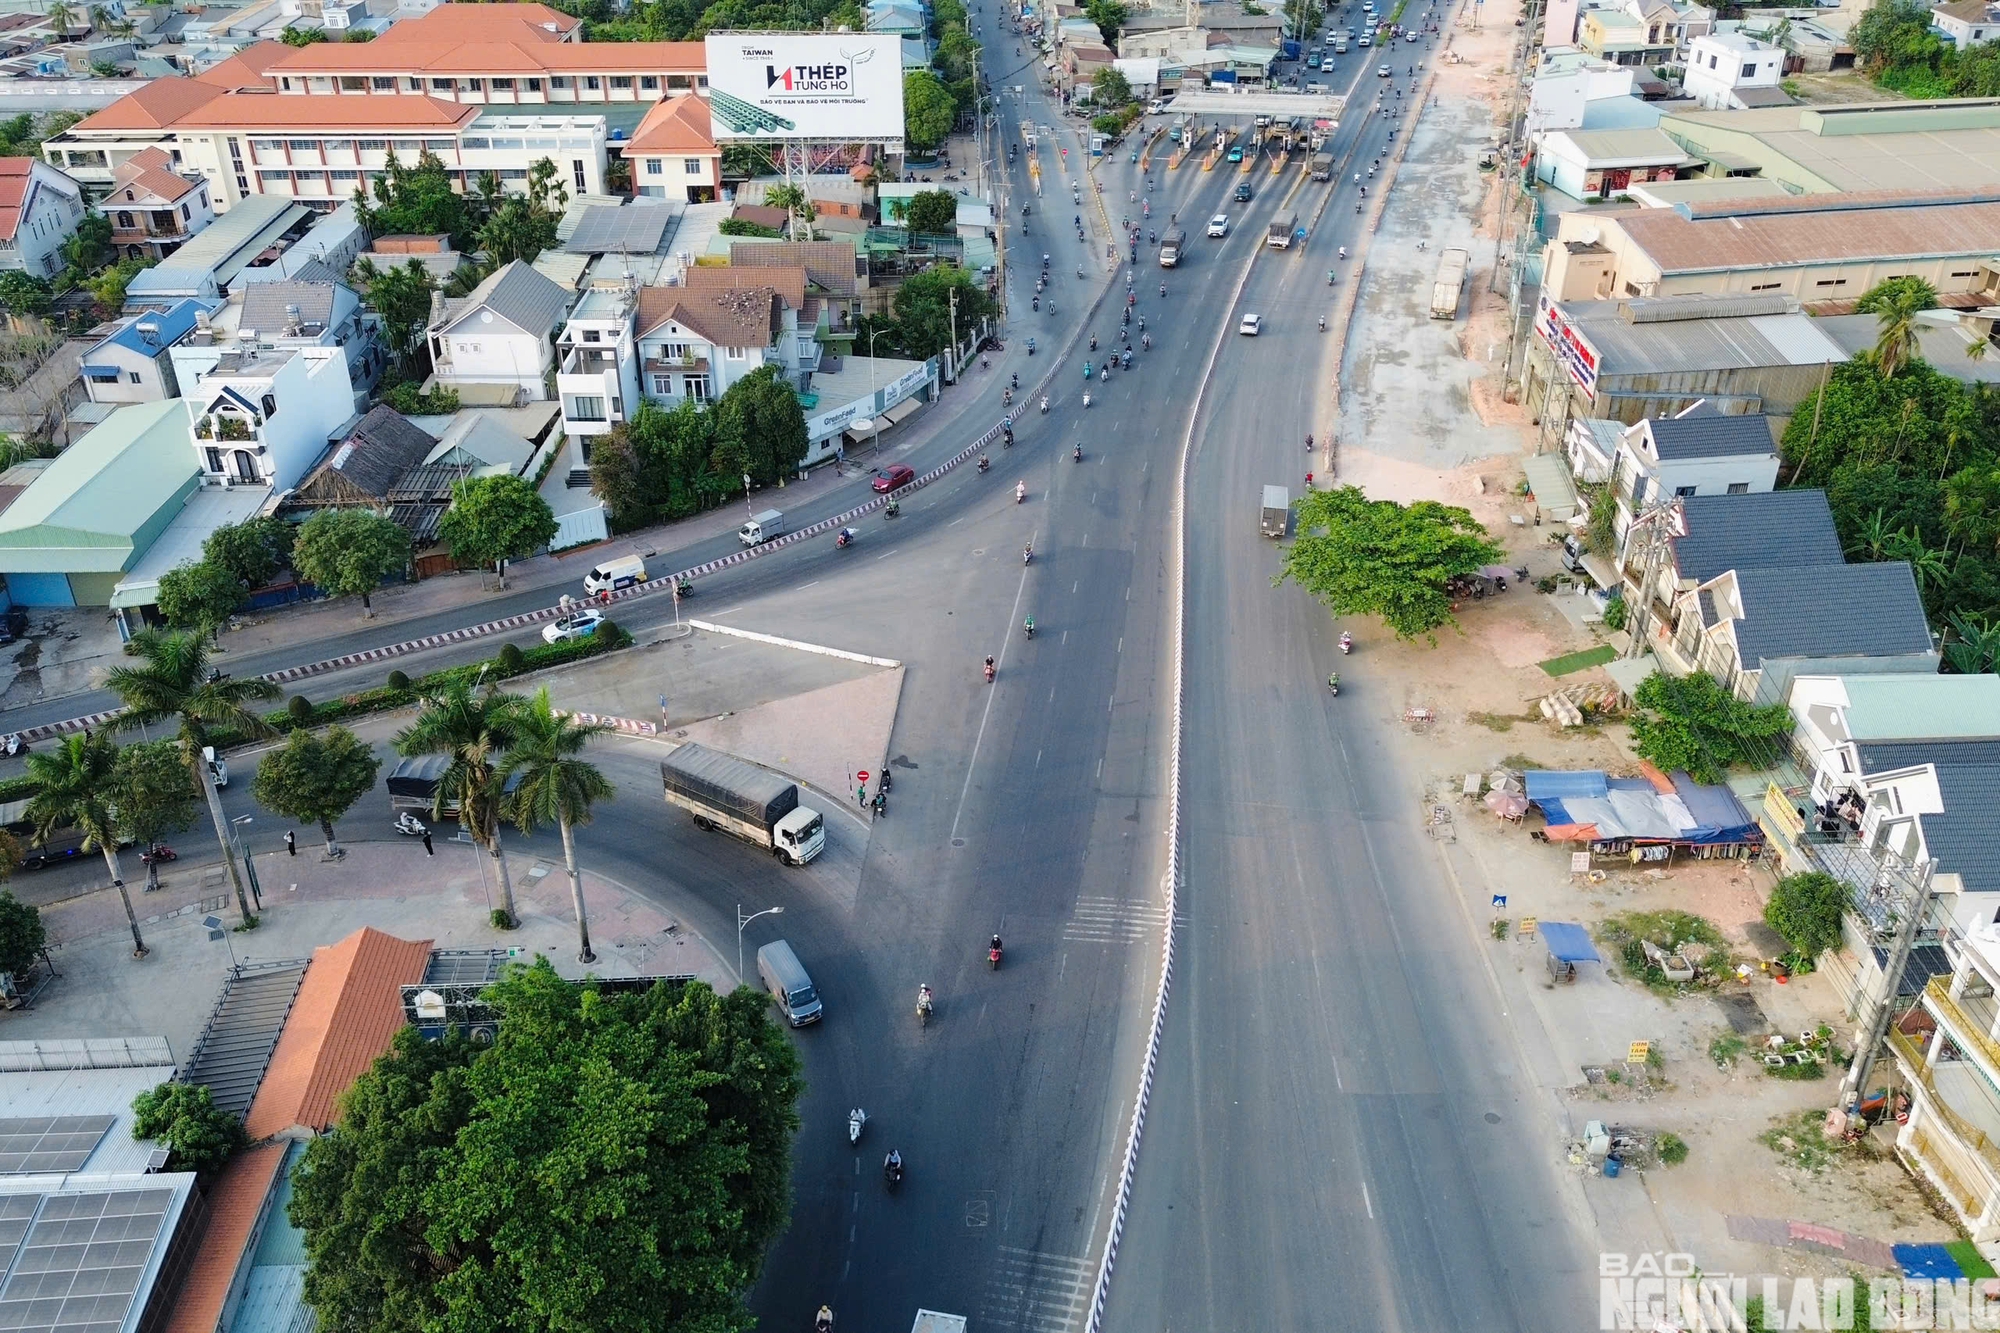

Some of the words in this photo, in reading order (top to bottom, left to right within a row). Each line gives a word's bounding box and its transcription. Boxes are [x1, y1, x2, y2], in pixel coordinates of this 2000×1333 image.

[795, 62, 847, 80] THÉP
[794, 81, 827, 91] TUNG
[830, 80, 848, 91] HO
